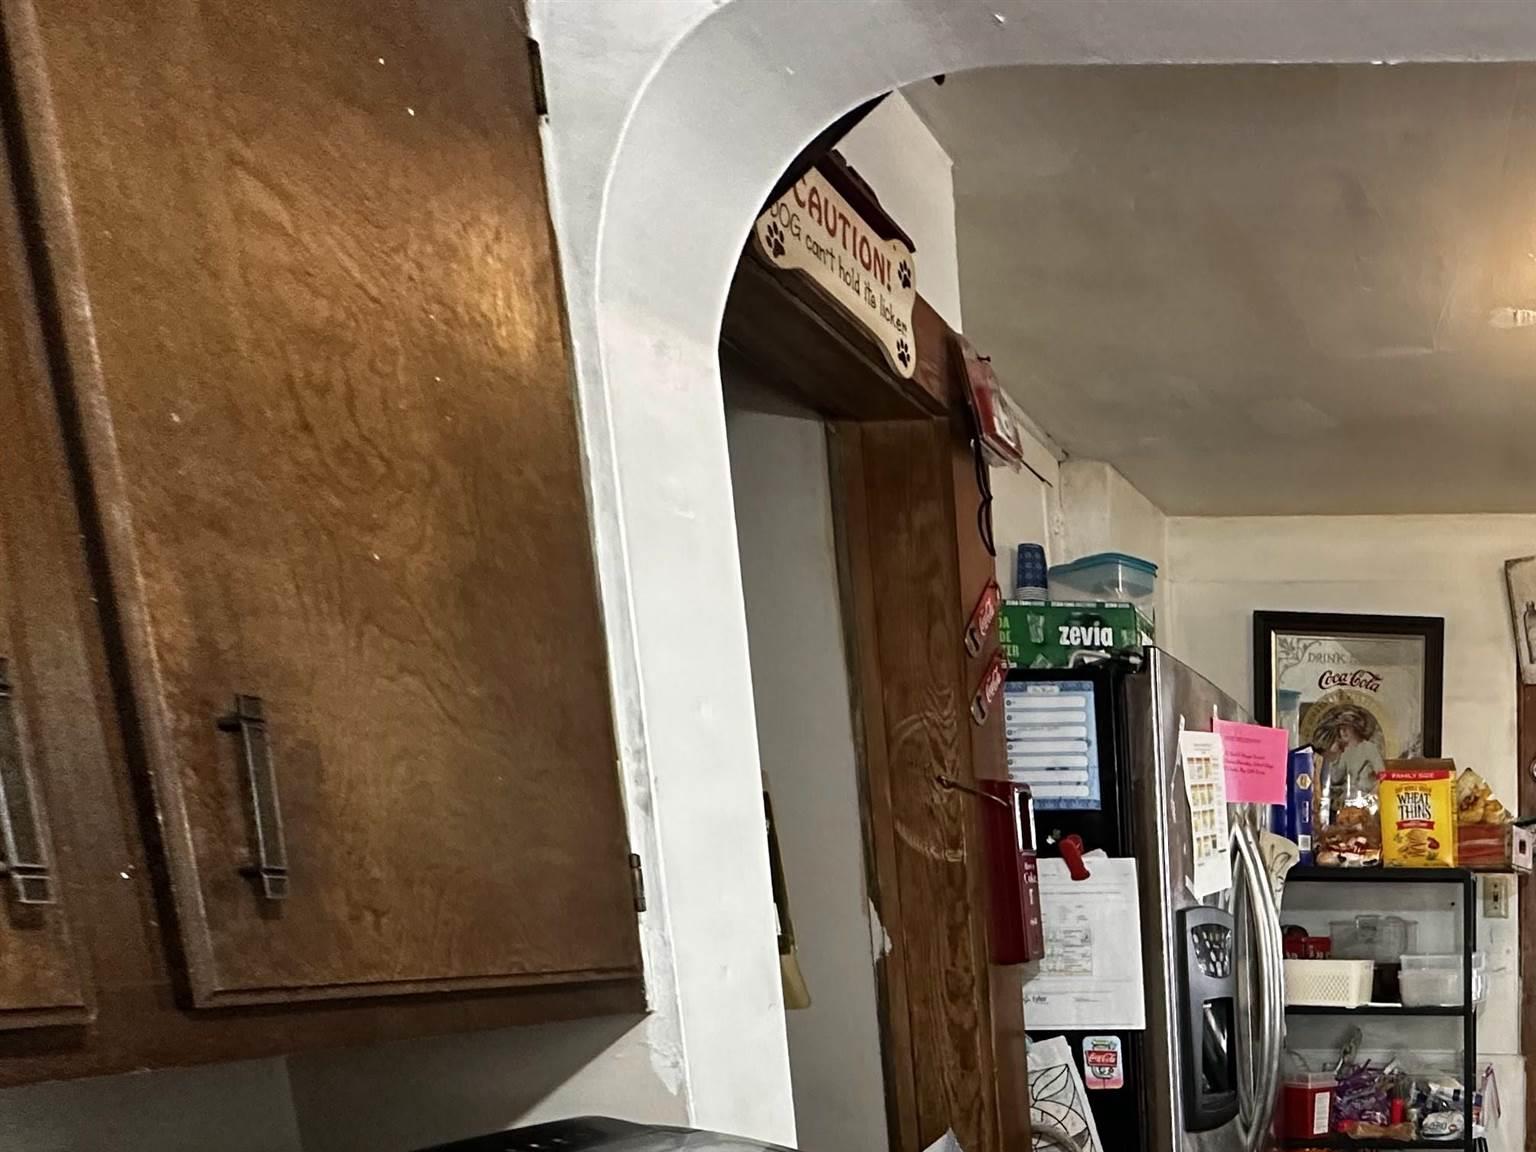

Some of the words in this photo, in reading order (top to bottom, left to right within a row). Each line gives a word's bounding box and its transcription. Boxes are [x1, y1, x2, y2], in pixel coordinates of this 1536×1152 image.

[793, 176, 893, 293] CAUTION!
[838, 256, 860, 296] hold
[1058, 620, 1114, 647] zevia
[1307, 652, 1347, 665] DRINK
[1317, 669, 1384, 693] Coca-Cola
[1396, 791, 1431, 806] WHEAT
[1398, 805, 1431, 821] THINS
